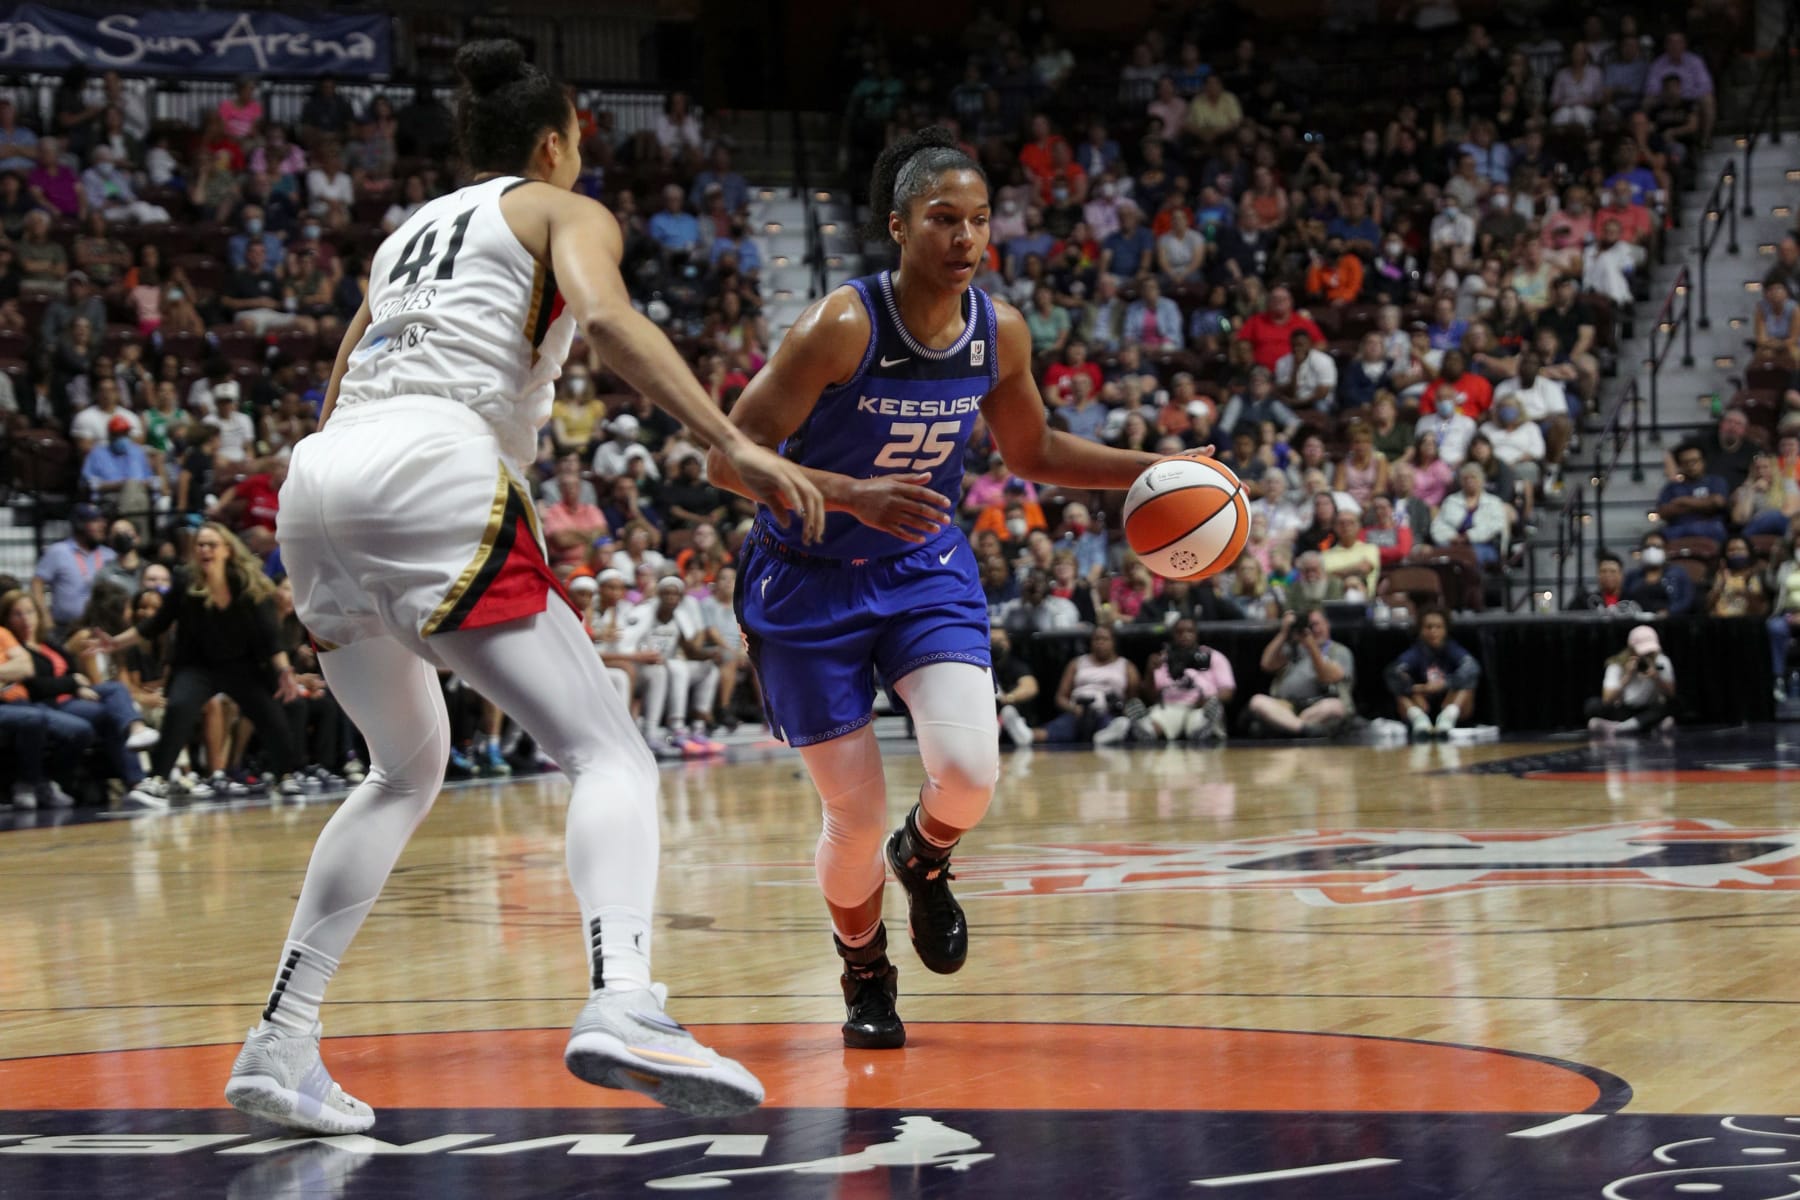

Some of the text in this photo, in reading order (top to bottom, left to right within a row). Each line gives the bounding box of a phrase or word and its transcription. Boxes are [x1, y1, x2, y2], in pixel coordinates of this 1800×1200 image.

[95, 14, 202, 65] Sun
[211, 13, 376, 71] Arena
[389, 204, 480, 286] 41
[857, 395, 983, 417] KEESUSK
[873, 420, 962, 471] 25
[0, 1133, 769, 1156] WNB
